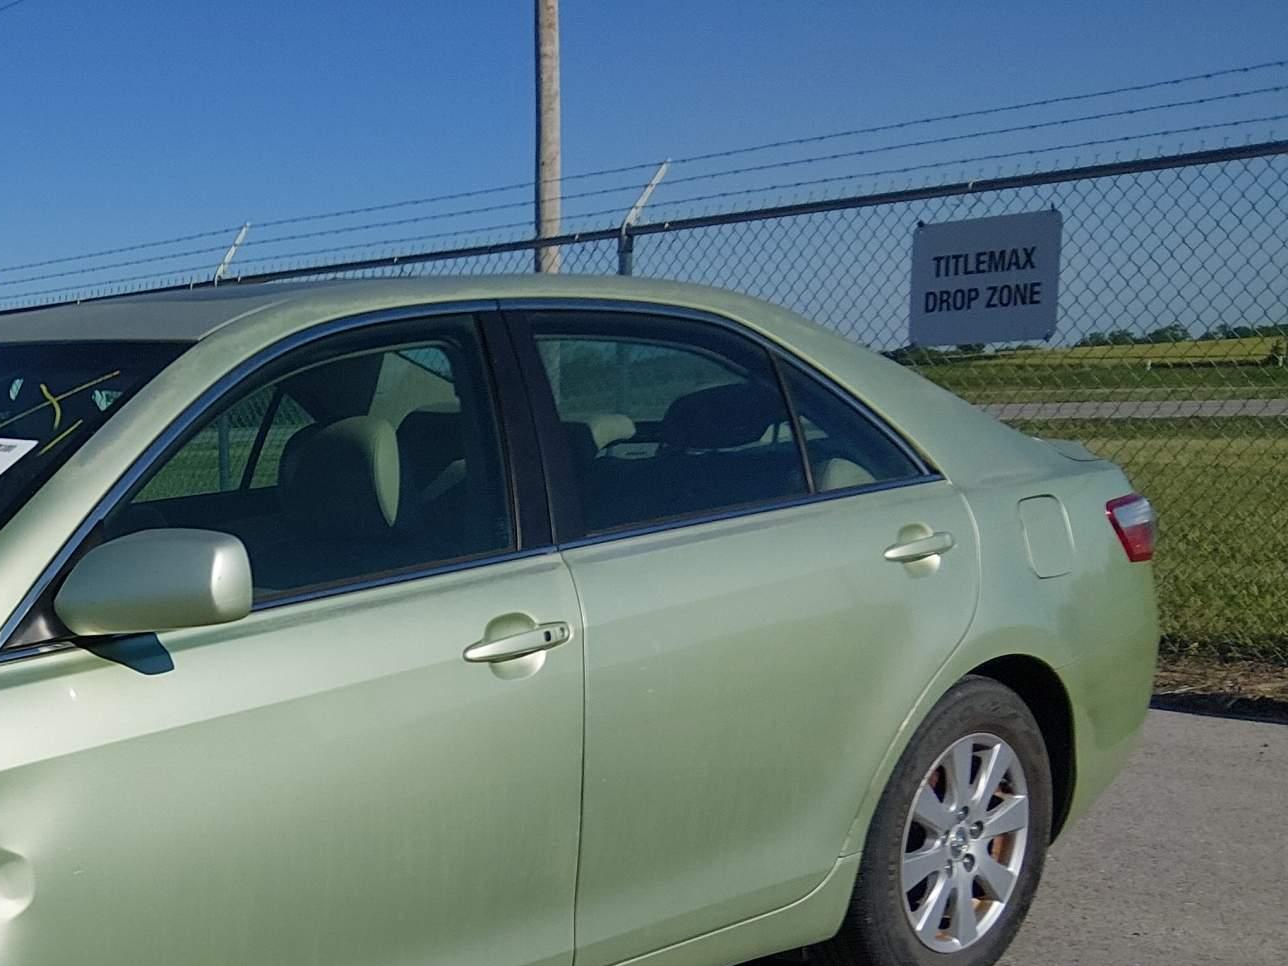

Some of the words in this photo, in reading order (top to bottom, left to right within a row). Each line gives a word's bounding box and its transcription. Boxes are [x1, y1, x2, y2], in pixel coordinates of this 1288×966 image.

[933, 246, 1037, 278] TITLEMAX
[924, 288, 980, 314] DROP
[985, 282, 1042, 309] ZONE
